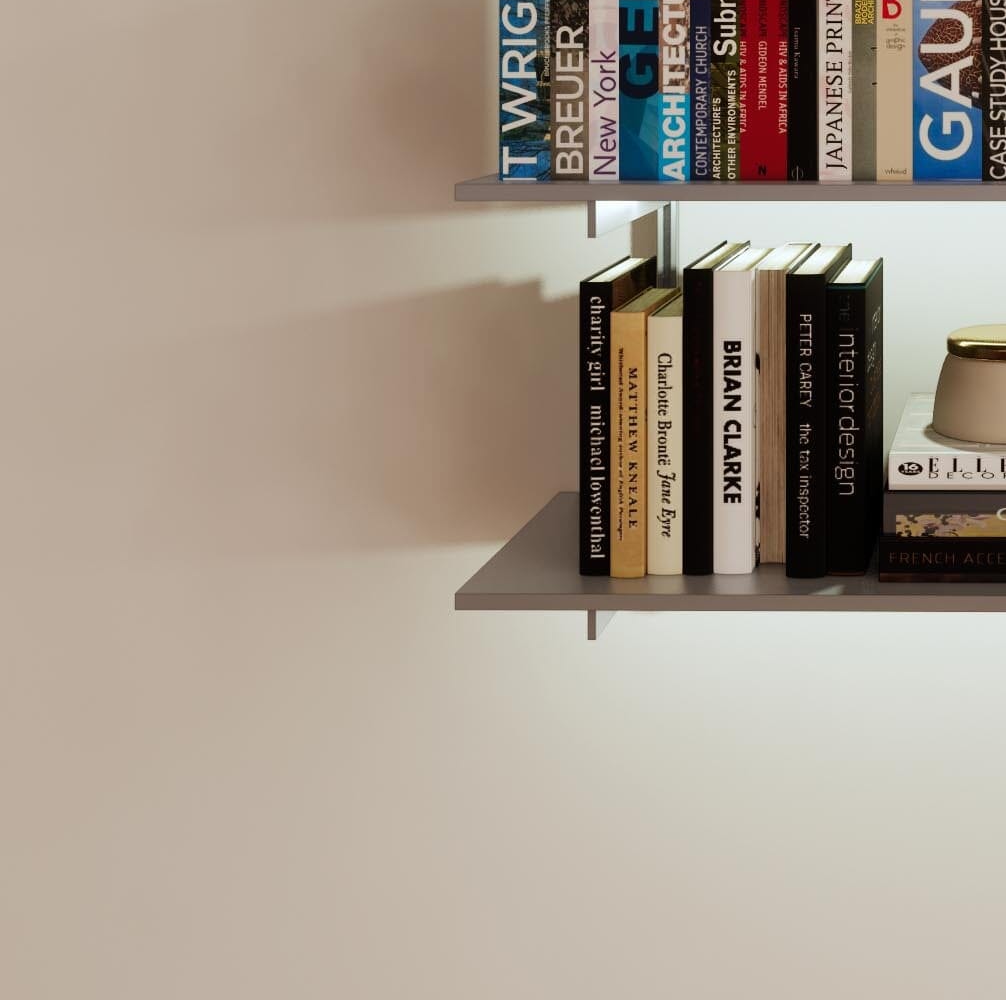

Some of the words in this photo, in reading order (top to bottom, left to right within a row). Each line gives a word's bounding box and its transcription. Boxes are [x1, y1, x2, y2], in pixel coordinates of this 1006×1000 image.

[695, 25, 708, 74] CHURCH
[757, 40, 766, 74] GIDEON
[778, 40, 787, 58] HIV
[556, 25, 584, 175] BREUER
[591, 49, 617, 107] York
[757, 76, 766, 111] MENDEL
[778, 68, 787, 89] AIDS
[778, 90, 787, 101] IN
[695, 77, 708, 175] CONTEMPORARY
[727, 68, 736, 144] ENVIRONMENTS
[778, 103, 787, 134] AFRICA
[825, 61, 847, 171] JAPANESE
[594, 115, 617, 175] New
[713, 96, 722, 179] ARCHITECTURE'S
[727, 146, 736, 179] OTHER
[586, 295, 605, 356] charity
[798, 313, 811, 357] PETER
[586, 361, 605, 391] girl
[656, 352, 672, 416] Charlotte
[723, 340, 741, 411] BRIAN
[798, 362, 811, 408] CAREY
[627, 367, 637, 453] MATTHEW
[589, 405, 605, 471] michael
[656, 420, 672, 466] Brontë
[798, 423, 811, 445] the
[723, 419, 741, 504] CLARKE
[798, 450, 811, 471] tax
[903, 463, 919, 471] 16
[627, 461, 637, 529] KNEALE
[656, 469, 676, 504] Jane
[795, 475, 811, 539] inspector
[589, 475, 605, 559] lowenthal
[656, 507, 675, 539] Eyre
[889, 552, 955, 565] FRENCH
